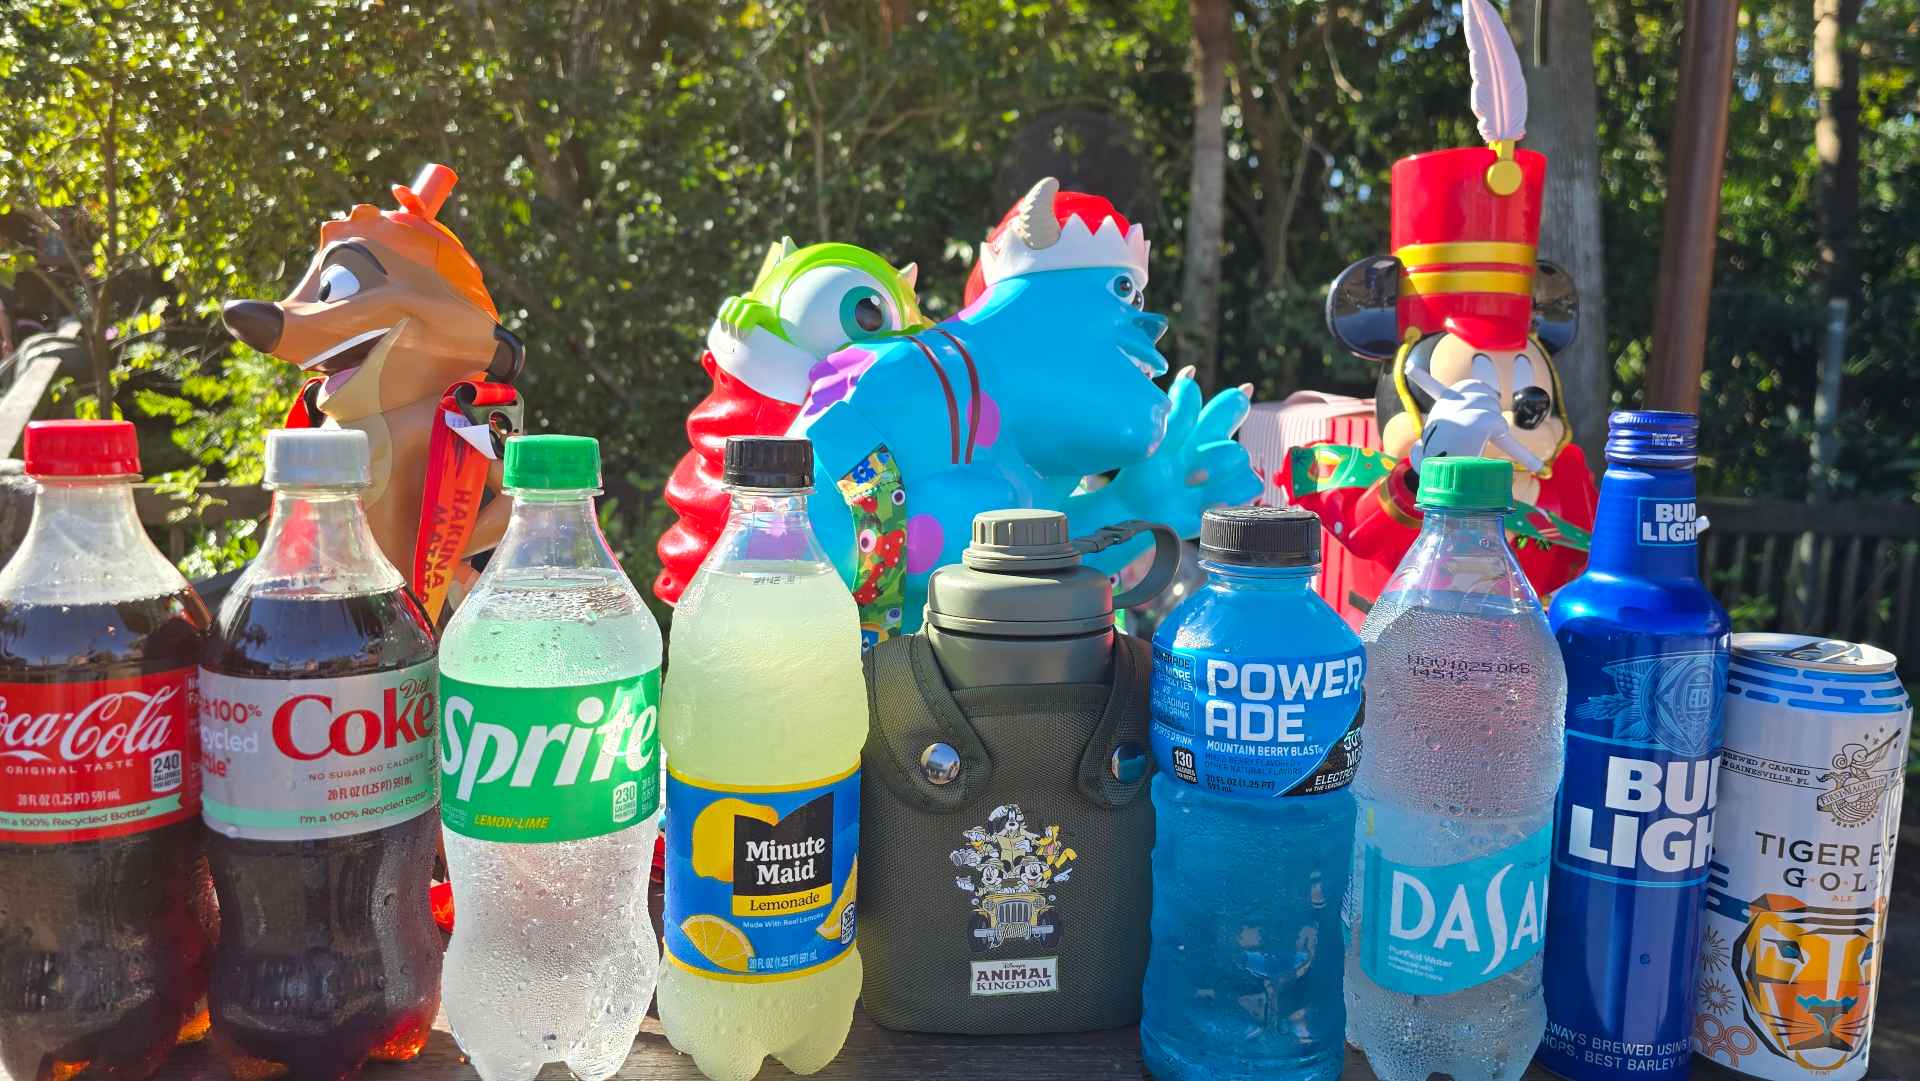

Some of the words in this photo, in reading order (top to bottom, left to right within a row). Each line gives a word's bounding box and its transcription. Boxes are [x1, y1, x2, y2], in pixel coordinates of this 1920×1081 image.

[1655, 503, 1697, 523] BUD
[432, 489, 472, 589] HAKUNA
[1642, 522, 1697, 542] LIGH
[1206, 655, 1363, 701] POWER
[213, 699, 263, 724] 100%
[1205, 700, 1305, 743] ADE
[272, 687, 434, 761] Coke
[441, 695, 657, 802] Sprite
[1171, 732, 1193, 746] DRINK
[1206, 740, 1256, 756] MOUNTAIN
[1257, 746, 1290, 757] BERRY
[1290, 745, 1320, 757] BLAST
[6, 765, 78, 776] ORIGINAL
[85, 759, 134, 772] TASTE
[153, 753, 180, 774] 240
[1174, 750, 1193, 769] 130
[1720, 750, 1758, 766] BREWED
[1768, 763, 1810, 776] CANNED
[309, 773, 325, 781] NO
[328, 767, 367, 780] SUGAR
[368, 764, 384, 774] NO
[1796, 777, 1809, 785] FL
[328, 789, 338, 801] 20
[339, 788, 348, 800] FL
[350, 786, 360, 798] OZ
[361, 783, 379, 796] (1.25
[615, 784, 635, 804] 230
[52, 813, 108, 827] Recycled
[299, 815, 317, 825] I'm
[329, 813, 359, 821] 100%
[361, 800, 404, 816] Recycled
[473, 813, 550, 830] LEMON-LIME
[1568, 804, 1716, 873] LIGH
[745, 836, 825, 862] Minute
[1755, 831, 1861, 867] TIGER
[756, 859, 816, 885] Maid
[750, 892, 820, 912] Lemonade
[743, 921, 763, 929] Made
[765, 918, 782, 928] With
[784, 917, 799, 927] Real
[1390, 863, 1549, 976] DASA
[766, 957, 774, 969] OZ
[1424, 953, 1455, 968] Water
[977, 967, 1052, 982] ANIMAL
[977, 979, 1051, 991] KINGDOM
[1591, 1036, 1653, 1057] BREWED
[1657, 1039, 1688, 1056] USING
[1584, 1050, 1623, 1070] BEST
[1627, 1057, 1676, 1072] BARLEY
